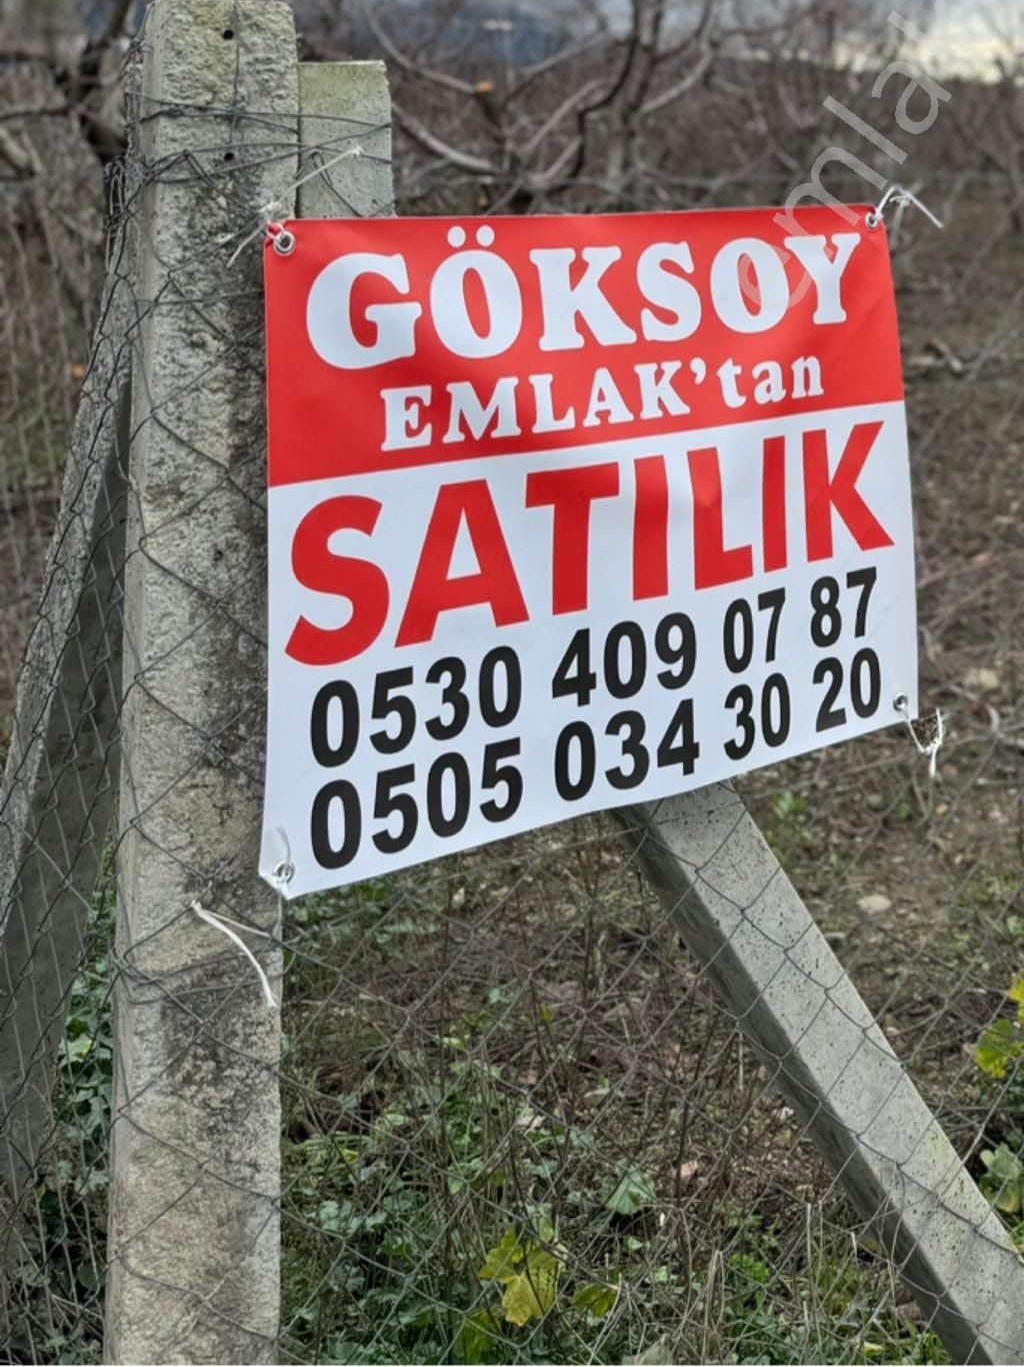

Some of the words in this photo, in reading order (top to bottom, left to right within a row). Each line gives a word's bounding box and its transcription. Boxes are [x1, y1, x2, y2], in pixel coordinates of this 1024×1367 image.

[306, 225, 861, 369] GÖKSOY
[380, 354, 824, 452] EMLAK’tan
[284, 421, 895, 666] SATILIK
[310, 646, 522, 767] 0530
[551, 612, 697, 707] 409
[723, 587, 786, 673] 07
[810, 567, 877, 648] 87
[310, 738, 523, 868] 0505
[554, 698, 699, 802] 034
[724, 673, 791, 760] 30
[812, 648, 881, 733] 20
